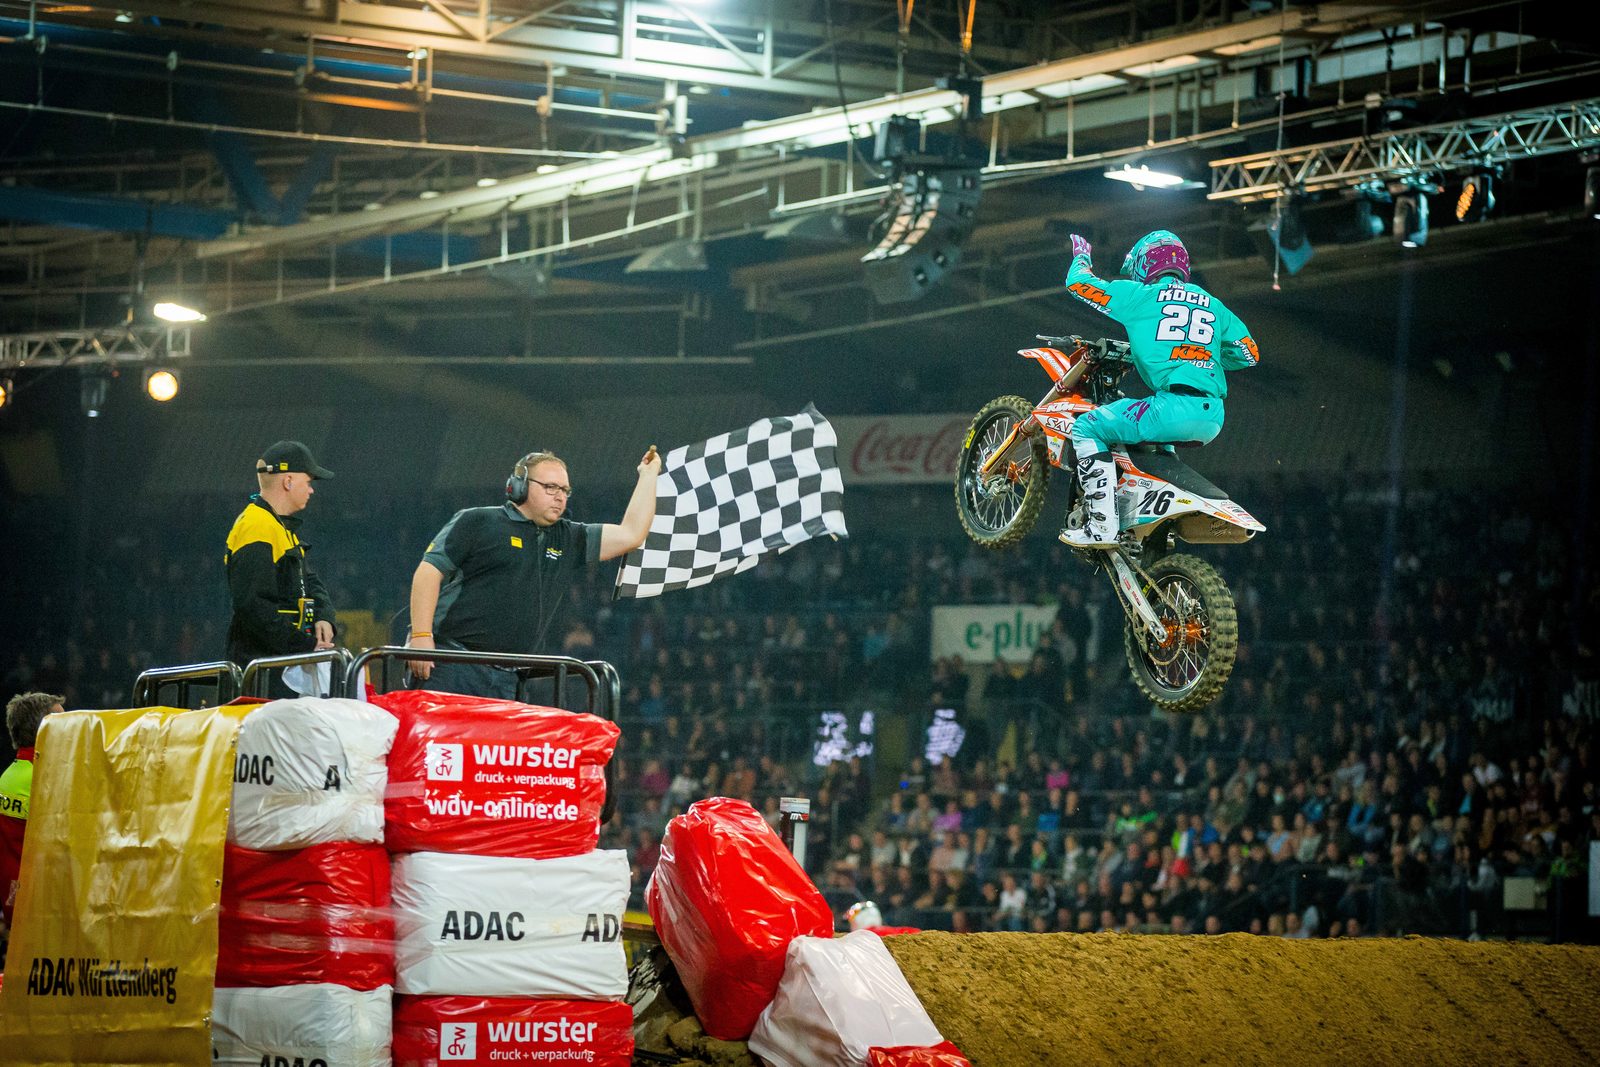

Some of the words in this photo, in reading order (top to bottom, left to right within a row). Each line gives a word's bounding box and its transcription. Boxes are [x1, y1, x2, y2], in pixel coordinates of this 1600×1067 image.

[1067, 282, 1112, 306] KTM
[1156, 288, 1211, 308] KOCH
[1155, 303, 1217, 346] 26
[1169, 343, 1212, 361] KTM
[1045, 402, 1076, 413] KTM
[1139, 490, 1175, 515] 26
[965, 608, 1041, 657] e-plu
[473, 743, 581, 769] wurster
[474, 771, 505, 784] druck
[513, 774, 576, 789] verpackung
[0, 797, 22, 813] OR
[428, 796, 579, 821] wdv-online.de
[440, 910, 525, 941] ADAC
[27, 957, 75, 997] ADAC
[78, 957, 178, 1004] Württemberg
[487, 1017, 597, 1043] wurster
[489, 1048, 521, 1061] druck
[532, 1049, 594, 1062] verpackung
